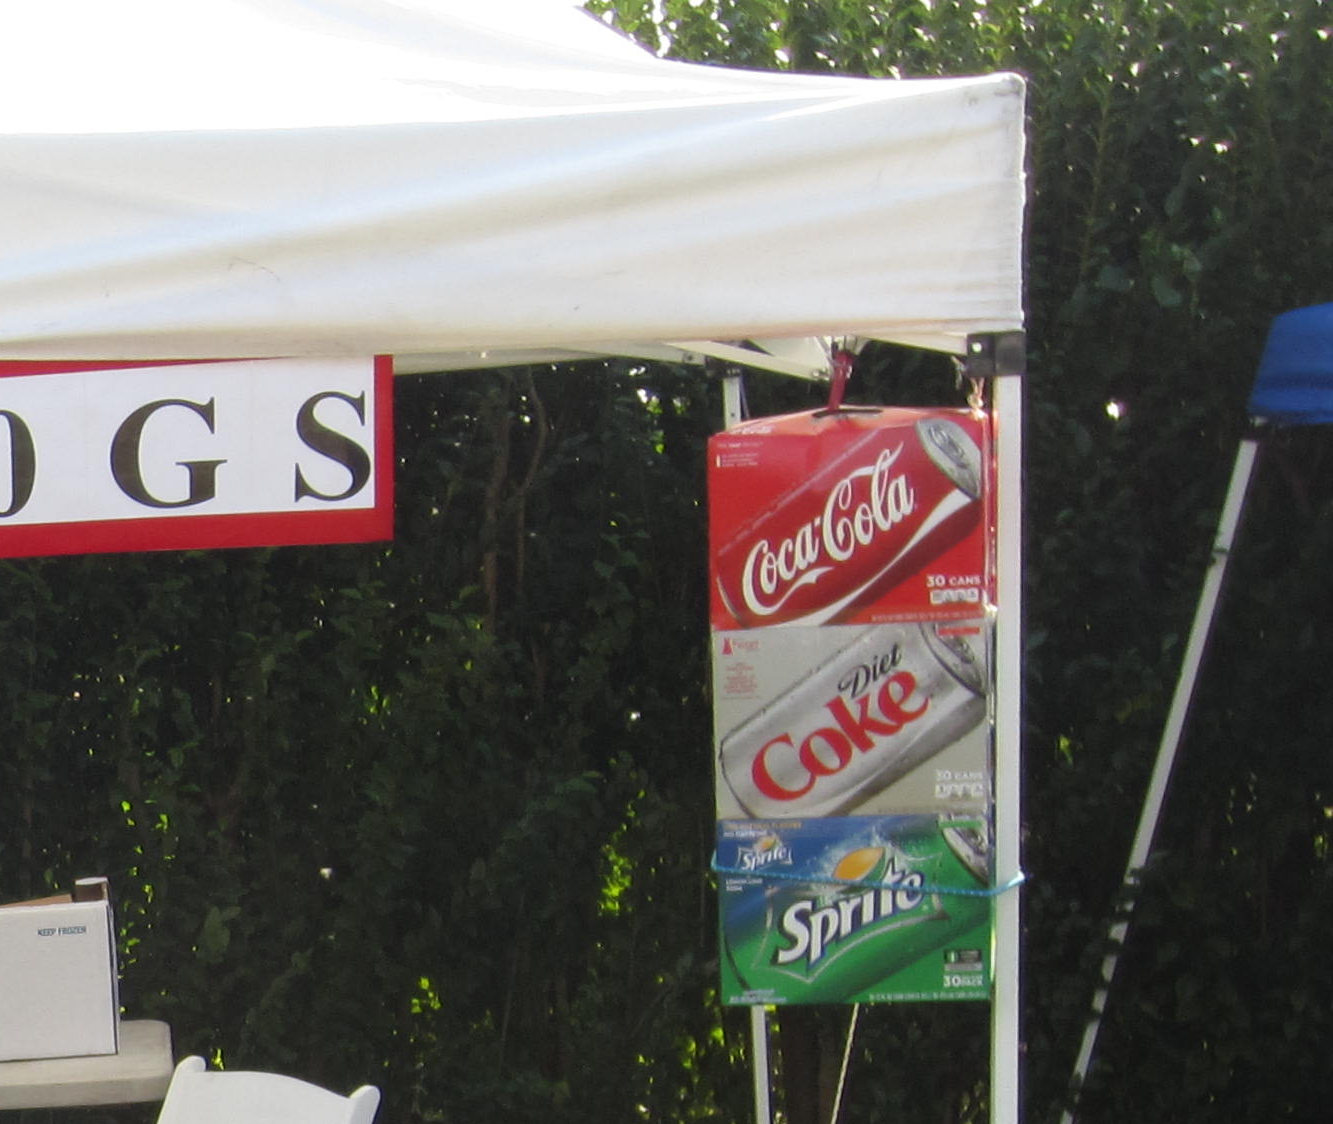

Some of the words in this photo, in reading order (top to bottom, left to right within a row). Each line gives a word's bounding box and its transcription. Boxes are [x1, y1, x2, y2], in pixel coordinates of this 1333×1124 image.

[742, 441, 914, 616] Coca-Cola
[926, 575, 945, 588] 30
[949, 575, 981, 586] CANS
[838, 643, 902, 699] Diet
[751, 671, 930, 802] Coke
[740, 846, 787, 871] Sprite
[37, 928, 57, 937] KEEP
[58, 926, 87, 935] FROZEN
[775, 856, 926, 968] Sprite
